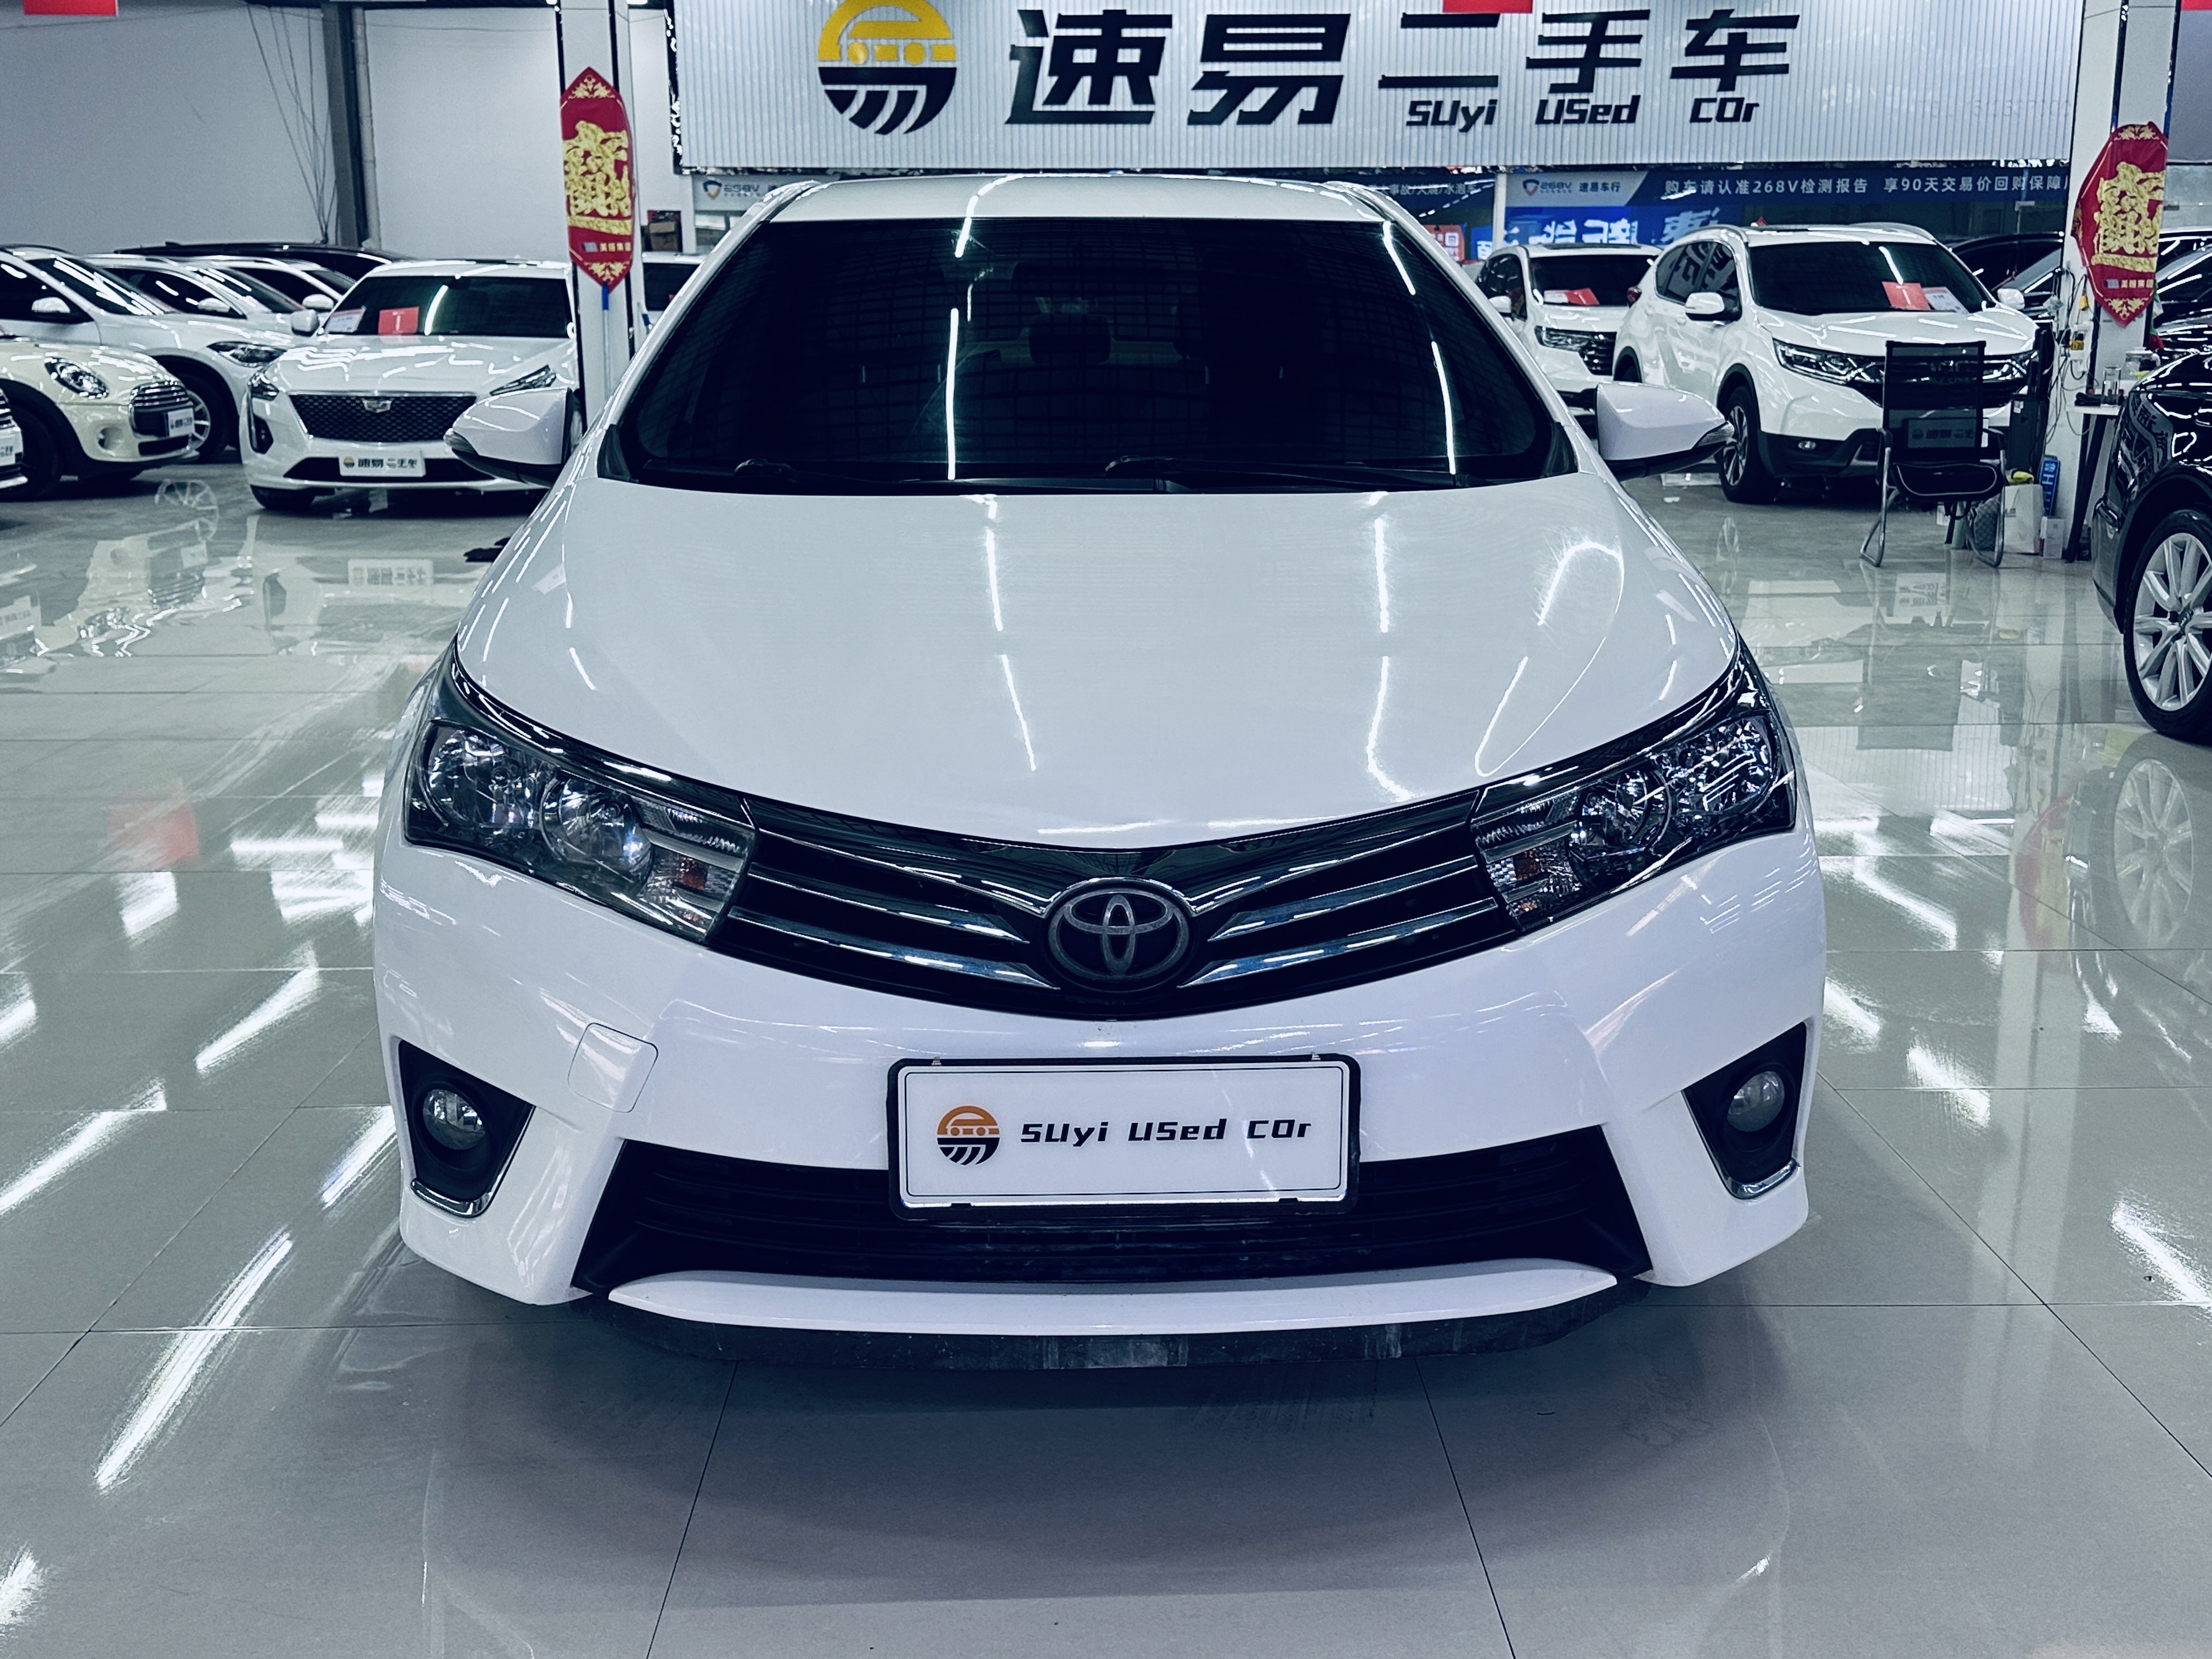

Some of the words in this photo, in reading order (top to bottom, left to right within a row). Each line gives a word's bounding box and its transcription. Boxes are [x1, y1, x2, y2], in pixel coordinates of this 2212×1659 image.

[1005, 8, 1801, 126] 速易二手车
[1883, 174, 2068, 193] 享90天交易价回购保障
